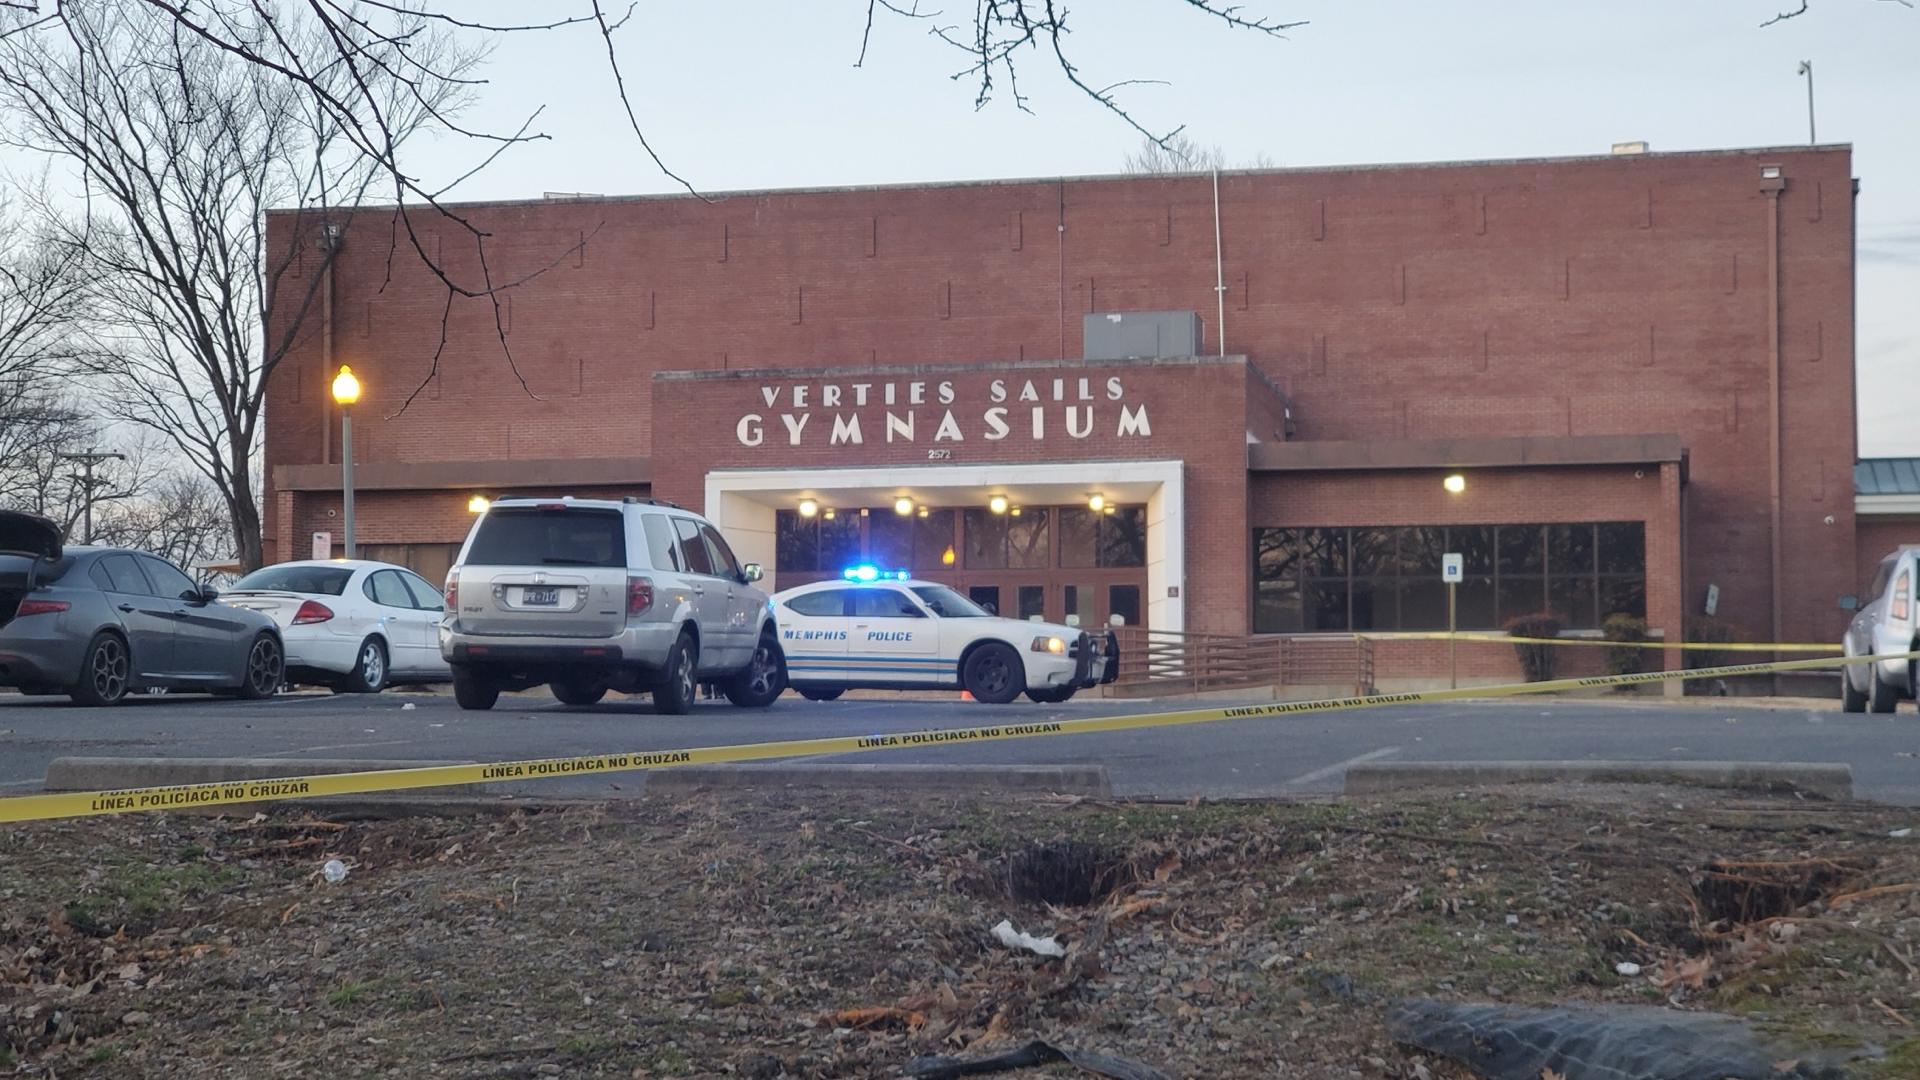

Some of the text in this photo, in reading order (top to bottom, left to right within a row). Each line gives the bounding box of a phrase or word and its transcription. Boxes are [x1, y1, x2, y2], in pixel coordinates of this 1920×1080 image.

[760, 376, 1124, 408] VERTIES SAILS
[736, 404, 1152, 447] GYMNASIUM
[928, 449, 951, 459] 2572
[783, 630, 913, 641] MEMPHIS POLICE
[1223, 693, 1422, 717] LINEA POLICIACA NO CRUZAR
[857, 723, 1062, 748] LINEA POLICIACA NO CRUZAR
[482, 752, 691, 778] LINEA POLICIACA NO CRUZAR
[92, 797, 134, 810] LINEA
[140, 790, 220, 807] POLICIACA
[224, 787, 244, 799] NO
[250, 782, 310, 797] CRUZAR
